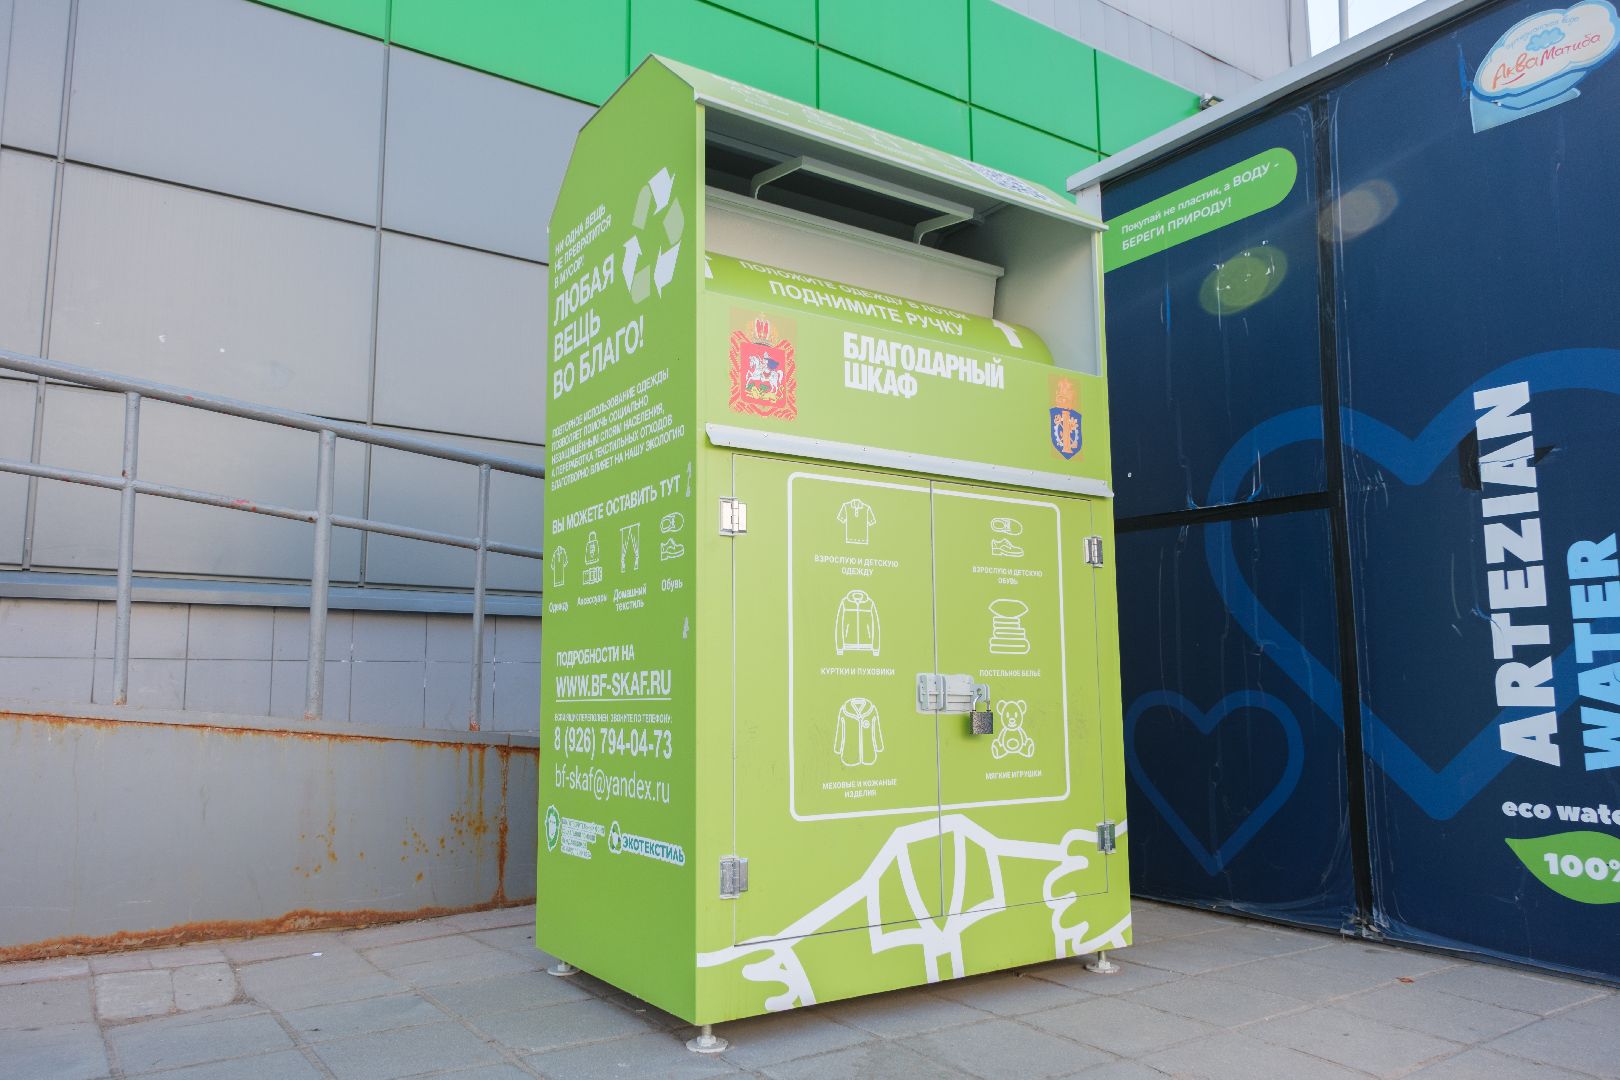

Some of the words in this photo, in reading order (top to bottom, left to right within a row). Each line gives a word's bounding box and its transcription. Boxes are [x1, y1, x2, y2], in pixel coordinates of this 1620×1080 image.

[1121, 211, 1162, 235] Покупай
[1164, 206, 1175, 217] не
[1178, 188, 1222, 210] пластик,
[1224, 183, 1231, 191] а
[1233, 162, 1270, 188] ВОДУ
[555, 241, 564, 257] НИ
[565, 222, 584, 248] ОДНА
[584, 203, 606, 230] ВЕЩЬ
[1122, 225, 1165, 251] БЕРЕГИ
[1167, 197, 1232, 232] ПРИРОДУ!
[554, 257, 563, 273] НЕ
[564, 214, 612, 263] ПРЕВРАТИТСЯ
[553, 253, 614, 327] ЛЮБАЯ
[554, 275, 559, 289] В
[740, 261, 837, 290] ПОЛОЖИТЕ
[839, 283, 902, 305] ОДЕЖДУ
[769, 281, 903, 324] ПОДНИМИТЕ
[905, 311, 963, 336] РУЧКУ
[554, 308, 601, 362] ВЕЩЬ
[553, 362, 575, 400] ВО
[579, 315, 644, 384] БЛАГО!
[843, 331, 1004, 390] БЛАГОДАРНЫЙ
[583, 386, 635, 421] ИСПОЛЬЗОВАНИЕ
[637, 368, 669, 394] ОДЕЖДЫ
[844, 361, 918, 399] ШКАФ
[584, 416, 607, 436] ПОМОЧЬ
[608, 395, 648, 423] СОЦИАЛЬНО
[623, 402, 664, 430] НАСЕЛЕНИЯ,
[591, 456, 613, 475] ВЛИЯЕТ
[614, 452, 623, 465] НА
[624, 443, 645, 461] НАШУ
[646, 425, 684, 451] ЭКОЛОГИЮ
[595, 430, 639, 458] ТЕКСТИЛЬНЫХ
[640, 414, 673, 437] ОТХОДОВ
[552, 517, 564, 534] ВЫ
[566, 503, 604, 530] МОЖЕТЕ
[606, 485, 657, 516] ОСТАВИТЬ
[660, 474, 680, 497] ТУТ
[814, 554, 857, 566] ВЗРОСЛУЮ
[864, 558, 899, 569] ДЕТСКУЮ
[841, 566, 874, 577] ОДЕЖДУ
[972, 566, 1007, 577] ВЗРОСЛУЮ
[1013, 568, 1043, 579] ДЕТСКУЮ
[1473, 381, 1561, 767] ARTEZIAN
[613, 583, 646, 602] Домашний
[662, 578, 683, 592] Обувь
[616, 599, 645, 612] текстиль
[557, 646, 619, 668] ПОДРОБНОСТИ
[621, 644, 635, 661] НА
[1567, 533, 1620, 771] WATER
[556, 669, 671, 698] WWW.BF-SKAF.RU
[820, 667, 849, 677] КУРТКИ
[857, 667, 895, 677] ПУХОВИКИ
[979, 669, 1020, 678] ПОСТЕЛЬНОЕ
[554, 727, 561, 751] 8
[564, 727, 596, 760] (926)
[600, 727, 672, 759] 794-04-73
[555, 763, 670, 804] bf-skaf@yandex.ru
[822, 780, 856, 791] МЕХОВЫЕ
[863, 777, 897, 788] КОЖАНЫЕ
[844, 788, 877, 799] ИЗДЕЛИЯ
[985, 771, 1011, 781] МЯГКИЕ
[1012, 769, 1042, 780] ИГРУШКИ
[1501, 801, 1552, 820] eco
[622, 834, 684, 863] ЭКОТЕКСТИЛЬ
